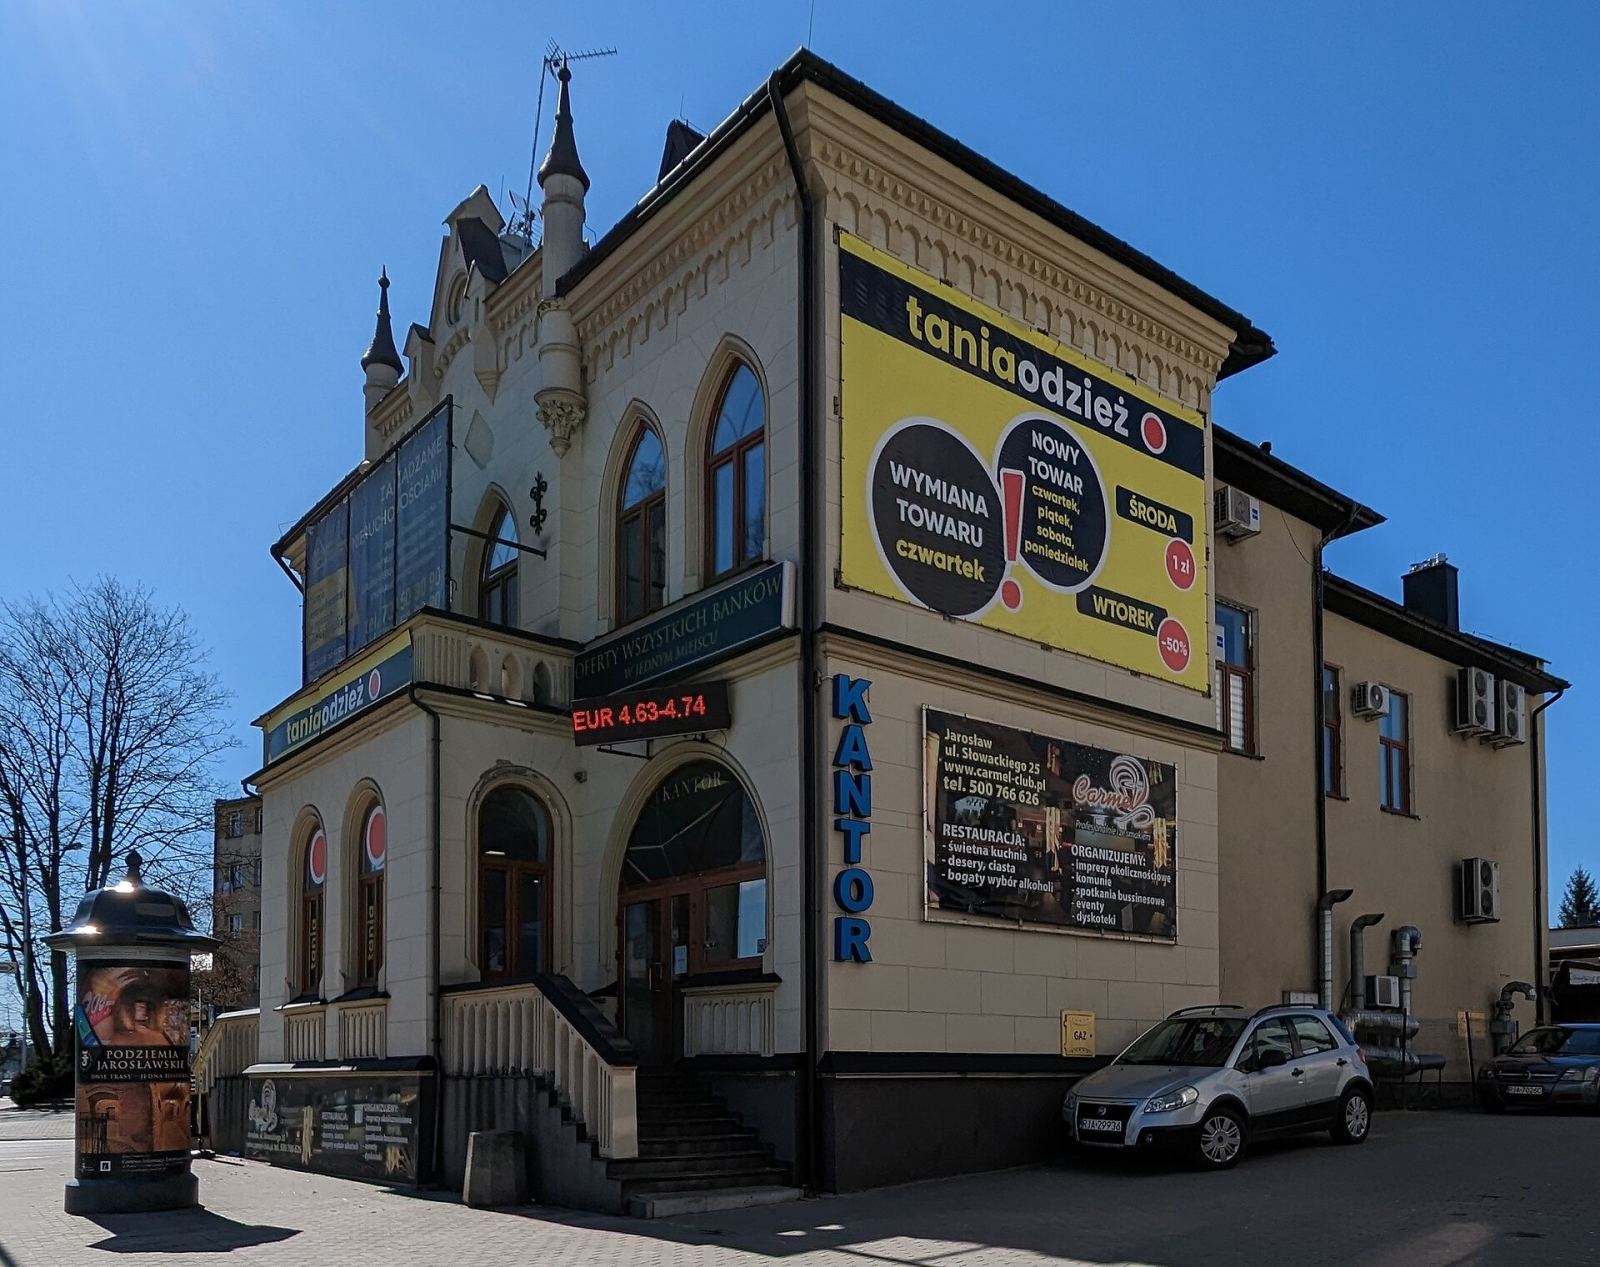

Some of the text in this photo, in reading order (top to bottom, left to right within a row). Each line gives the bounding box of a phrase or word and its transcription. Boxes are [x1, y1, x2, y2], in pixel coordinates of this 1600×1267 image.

[905, 295, 1129, 437] taniaodzież
[1031, 430, 1080, 465] NOWY
[890, 460, 989, 518] WYMIANA
[1028, 456, 1084, 496] TOWAR
[1031, 484, 1080, 515] czwartek,
[1129, 494, 1178, 533] ŚRODA
[895, 498, 983, 549] TOWARU
[1037, 506, 1073, 531] piątek,
[1036, 523, 1075, 550] sobota,
[895, 538, 985, 583] czwartek
[1172, 555, 1178, 570] 1
[1092, 594, 1154, 630] WTOREK
[576, 573, 781, 680] OFERTY WSZYSTKICH BANKÓW
[1161, 636, 1188, 657] -50%
[286, 679, 364, 745] taniaodzież
[572, 694, 706, 732] EUR 4.63-4.74
[944, 728, 992, 749] Jarosław
[945, 744, 1041, 775] ul. Słowackiego 25
[662, 771, 721, 802] KANTOR
[943, 776, 1040, 806] tel. 500 766 626
[944, 761, 1046, 793] www.carmel-club.pl
[832, 673, 874, 962] KANTOR
[942, 823, 1025, 847] RESTAURACJA:
[948, 840, 989, 856] świetna
[991, 846, 1028, 862] kuchnia
[948, 855, 986, 872] desery,
[988, 860, 1016, 873] ciasta
[1071, 844, 1146, 866] ORGANIZUJEMY:
[947, 869, 985, 886] bogaty
[987, 875, 1018, 888] wybór
[1019, 878, 1054, 893] alkoholi
[1076, 859, 1109, 875] imprezy
[1076, 872, 1112, 887] komunie
[1075, 887, 1117, 900] spotkania
[1118, 890, 1165, 906] bussinesowe
[1076, 900, 1105, 913] eventy
[1076, 911, 1116, 925] dyskoteki
[1073, 1031, 1087, 1041] GAZ
[106, 1049, 178, 1059] PODZIEMIA
